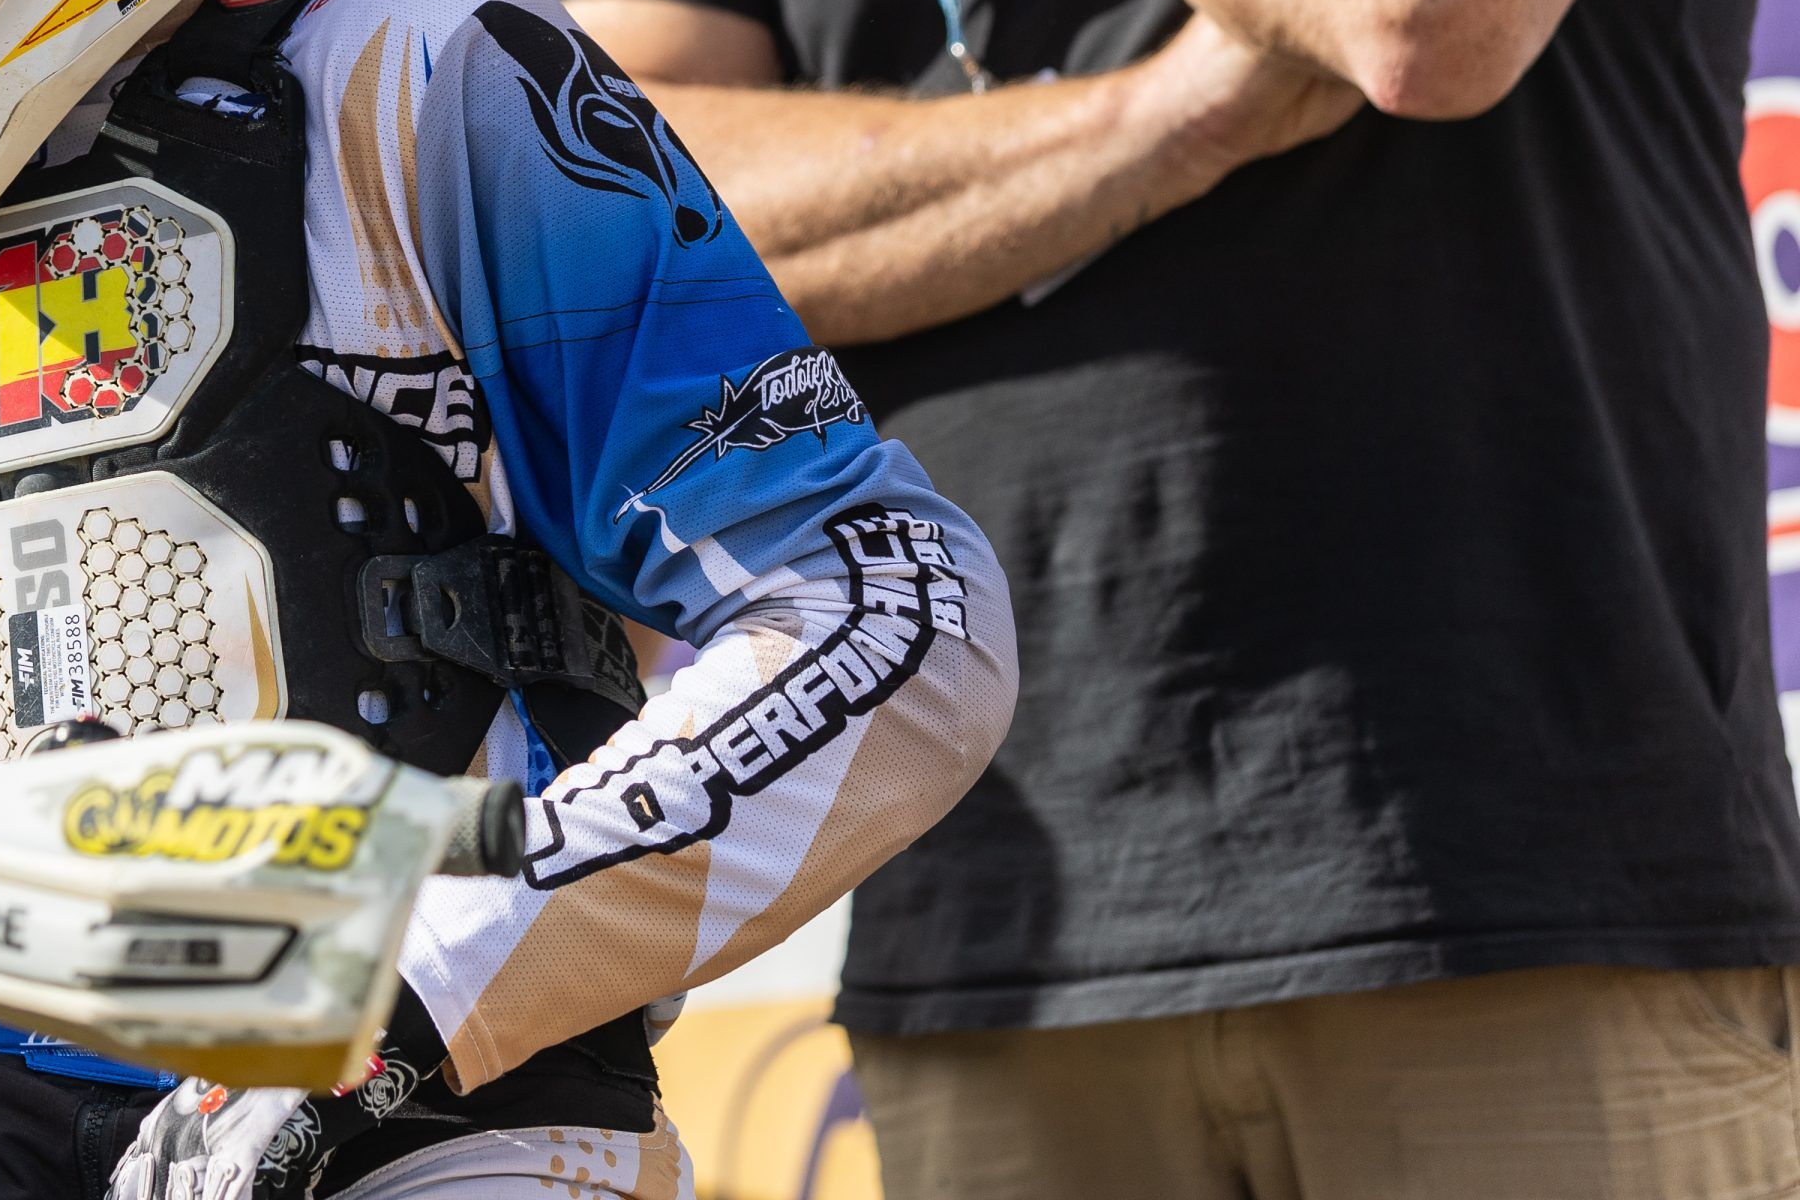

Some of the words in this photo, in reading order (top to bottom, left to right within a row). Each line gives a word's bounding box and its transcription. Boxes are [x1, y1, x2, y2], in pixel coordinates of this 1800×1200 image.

[17, 647, 35, 692] FIM
[64, 613, 85, 678] 38588
[71, 677, 87, 713] FIM
[148, 802, 368, 871] MOTOS
